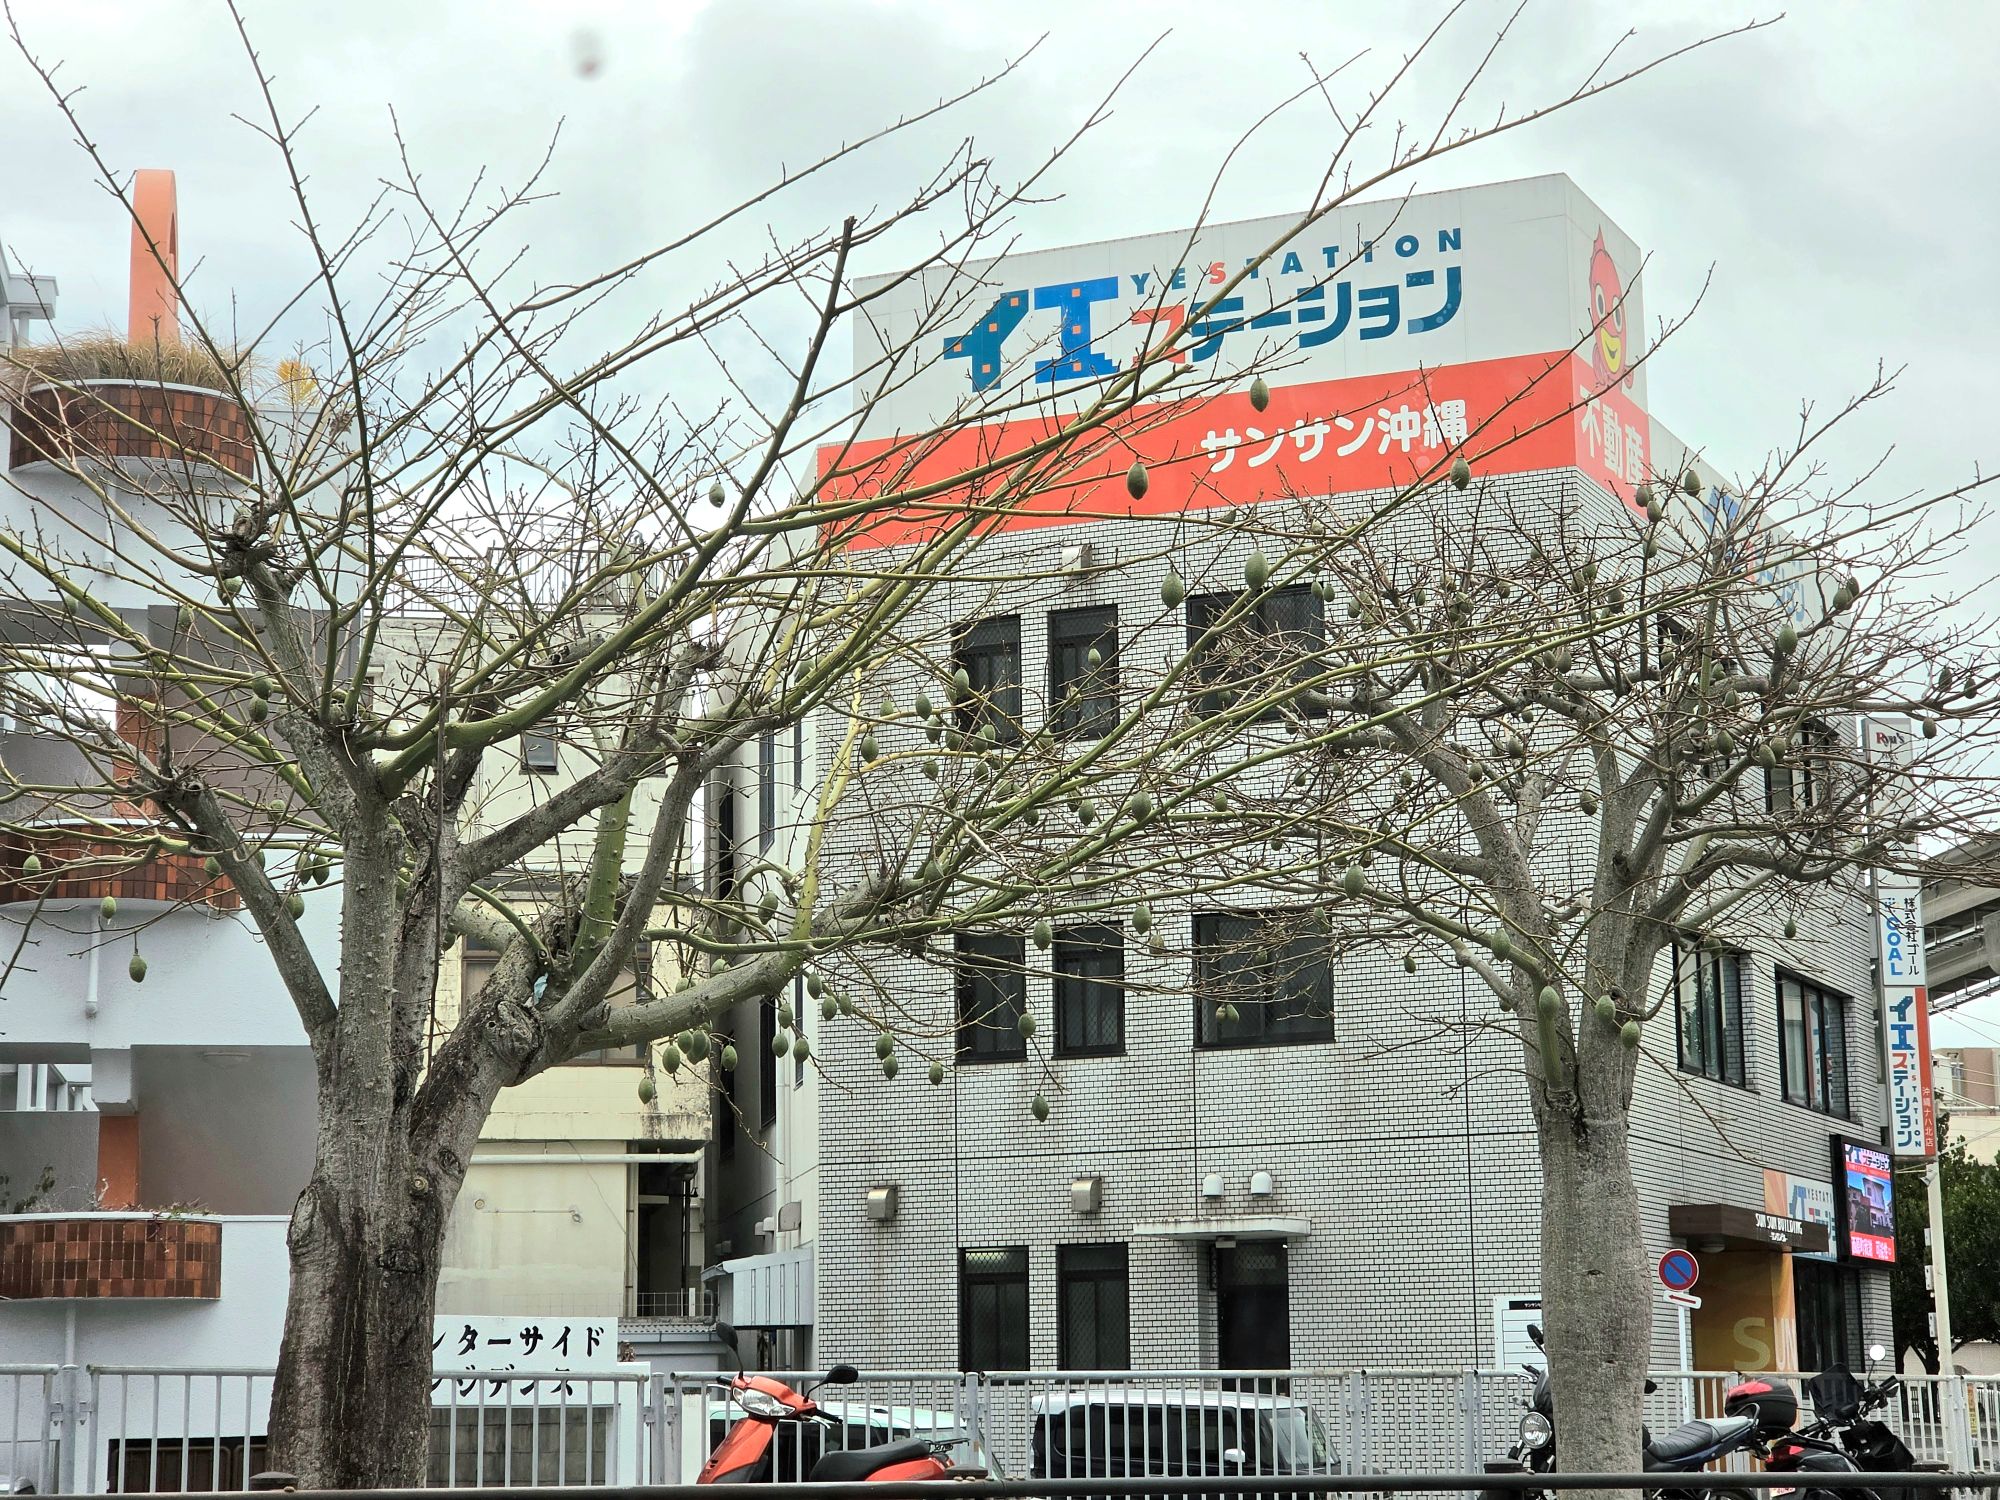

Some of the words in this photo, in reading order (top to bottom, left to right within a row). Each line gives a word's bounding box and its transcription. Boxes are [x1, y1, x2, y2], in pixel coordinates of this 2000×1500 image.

[1130, 228, 1462, 295] YESTATION
[943, 266, 1462, 392] イエステーション
[1201, 399, 1469, 473] サンサン沖縄
[1579, 384, 1644, 486] 不動産
[1886, 916, 1904, 976] GOAL
[1904, 897, 1920, 976] 株式会社ゴール
[1889, 995, 1916, 1148] イエステーション
[1910, 1052, 1922, 1148] YESTATION
